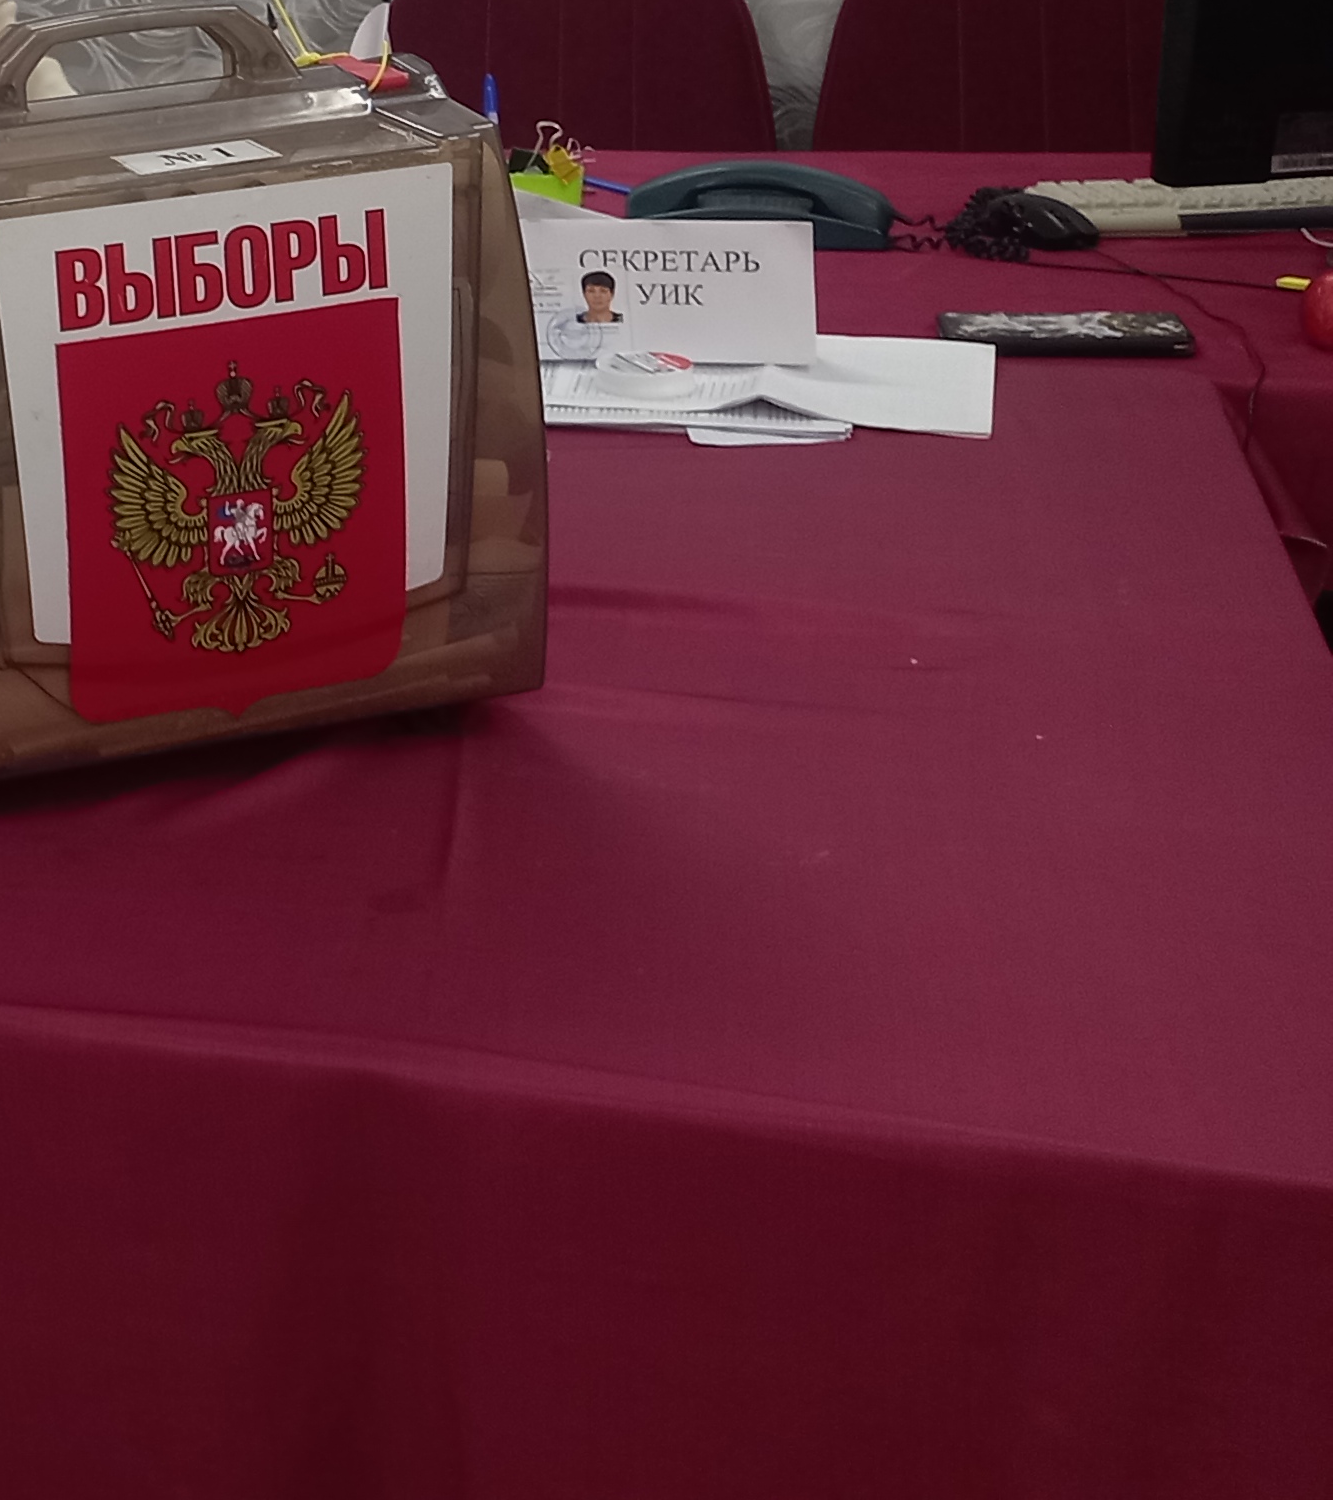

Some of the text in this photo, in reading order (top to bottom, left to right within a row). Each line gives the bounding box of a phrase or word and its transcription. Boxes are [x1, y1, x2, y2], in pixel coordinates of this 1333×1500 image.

[211, 147, 235, 158] 1
[54, 208, 389, 332] ВЫБОРЫ
[579, 249, 761, 273] СЕКРЕТАРЬ
[635, 283, 704, 306] УИК
